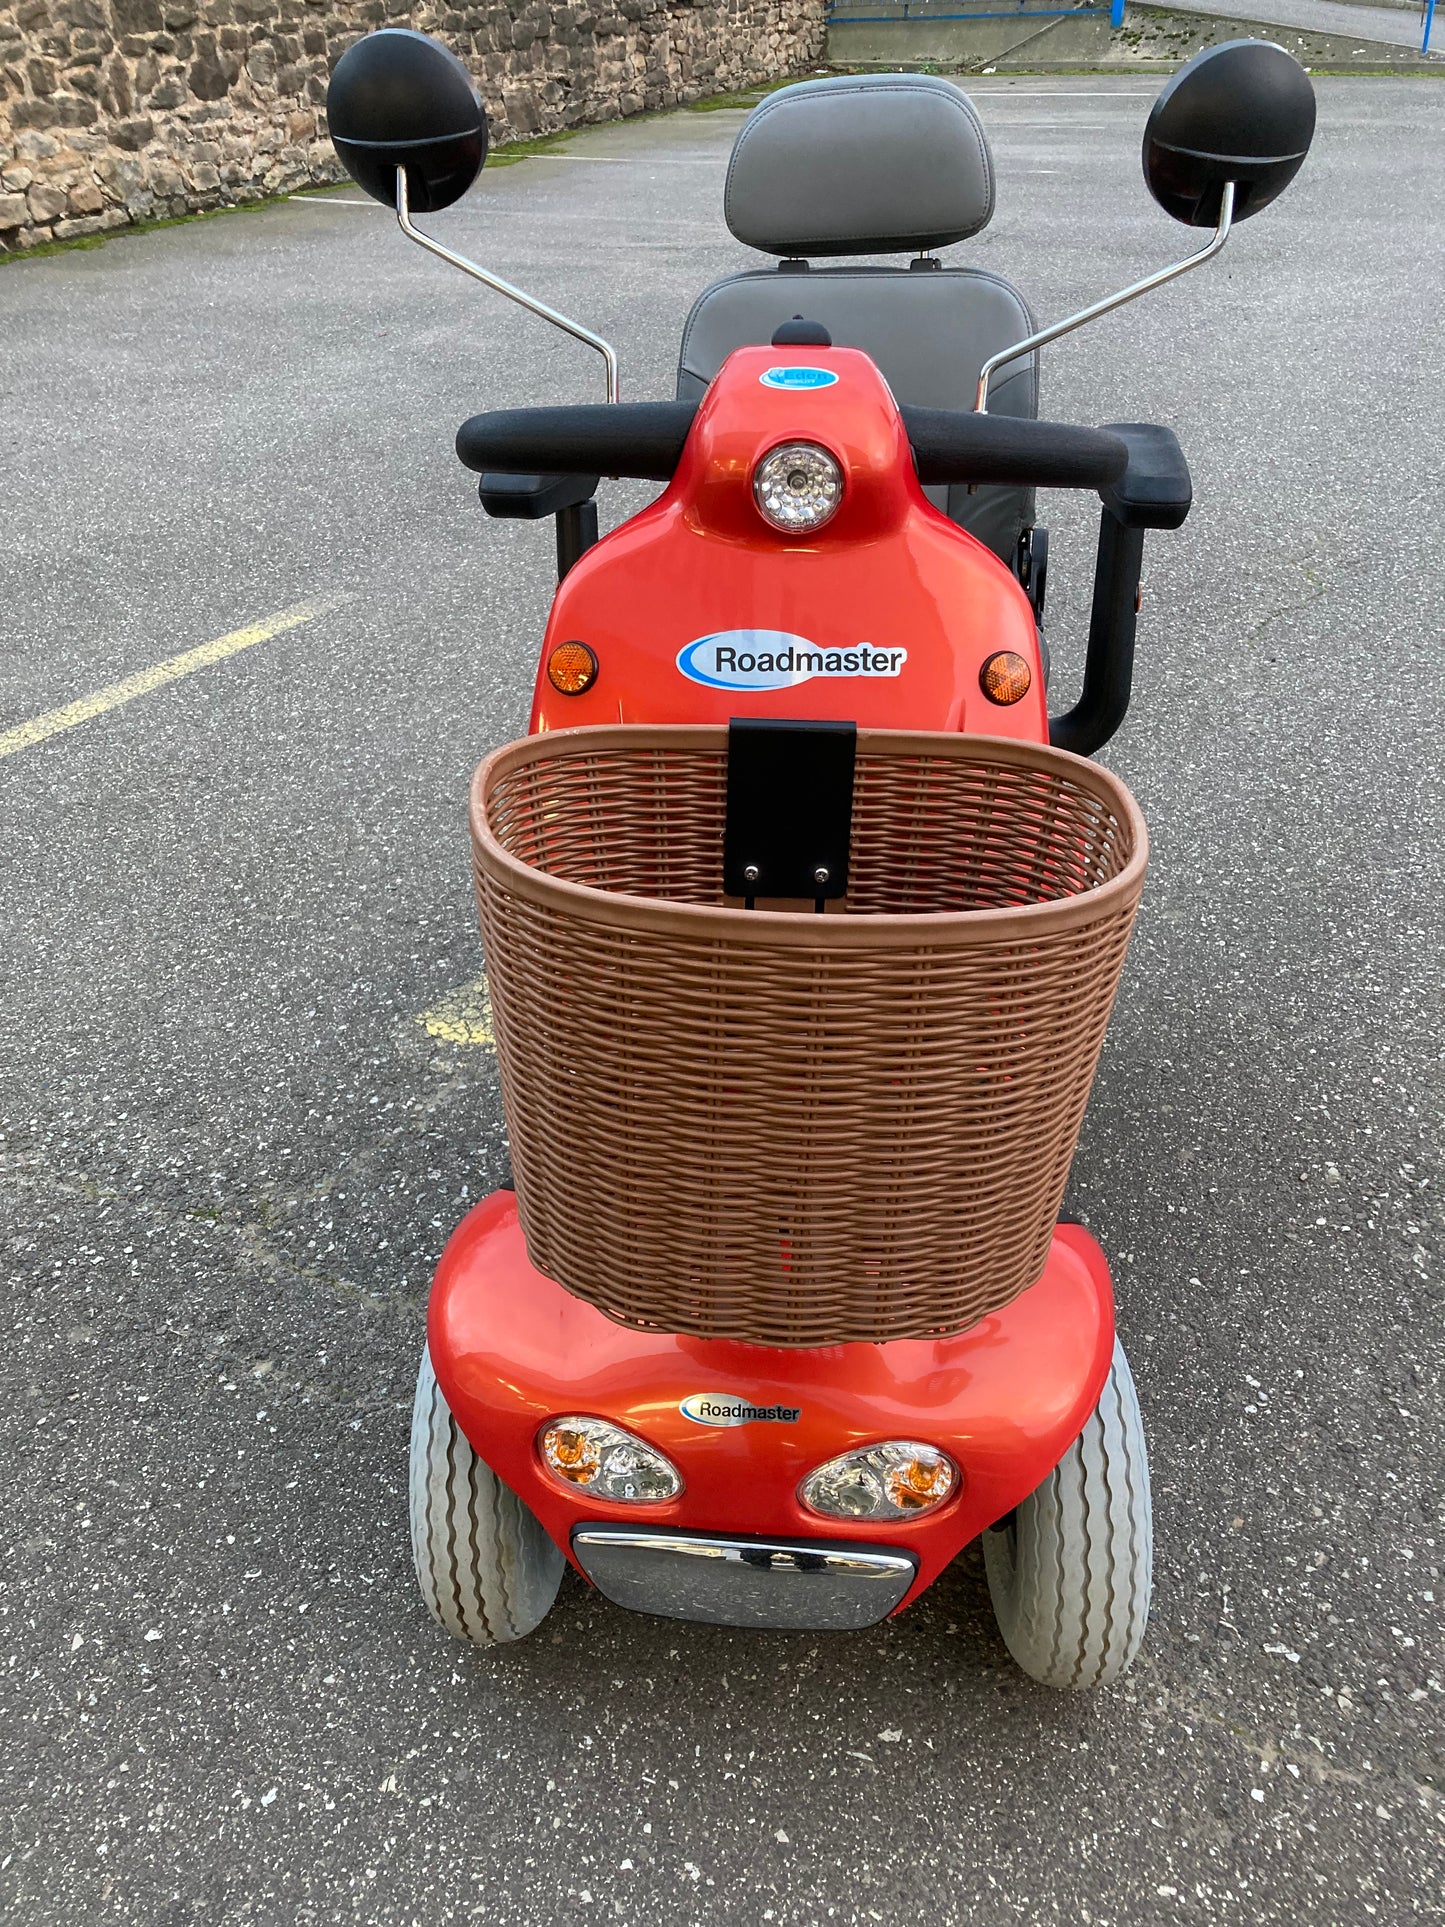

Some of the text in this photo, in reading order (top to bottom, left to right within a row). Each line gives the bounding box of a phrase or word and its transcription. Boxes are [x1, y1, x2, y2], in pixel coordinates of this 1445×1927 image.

[784, 371, 827, 380] Eden
[715, 647, 902, 672] Roadmaster
[700, 1402, 799, 1420] Roadmaster
